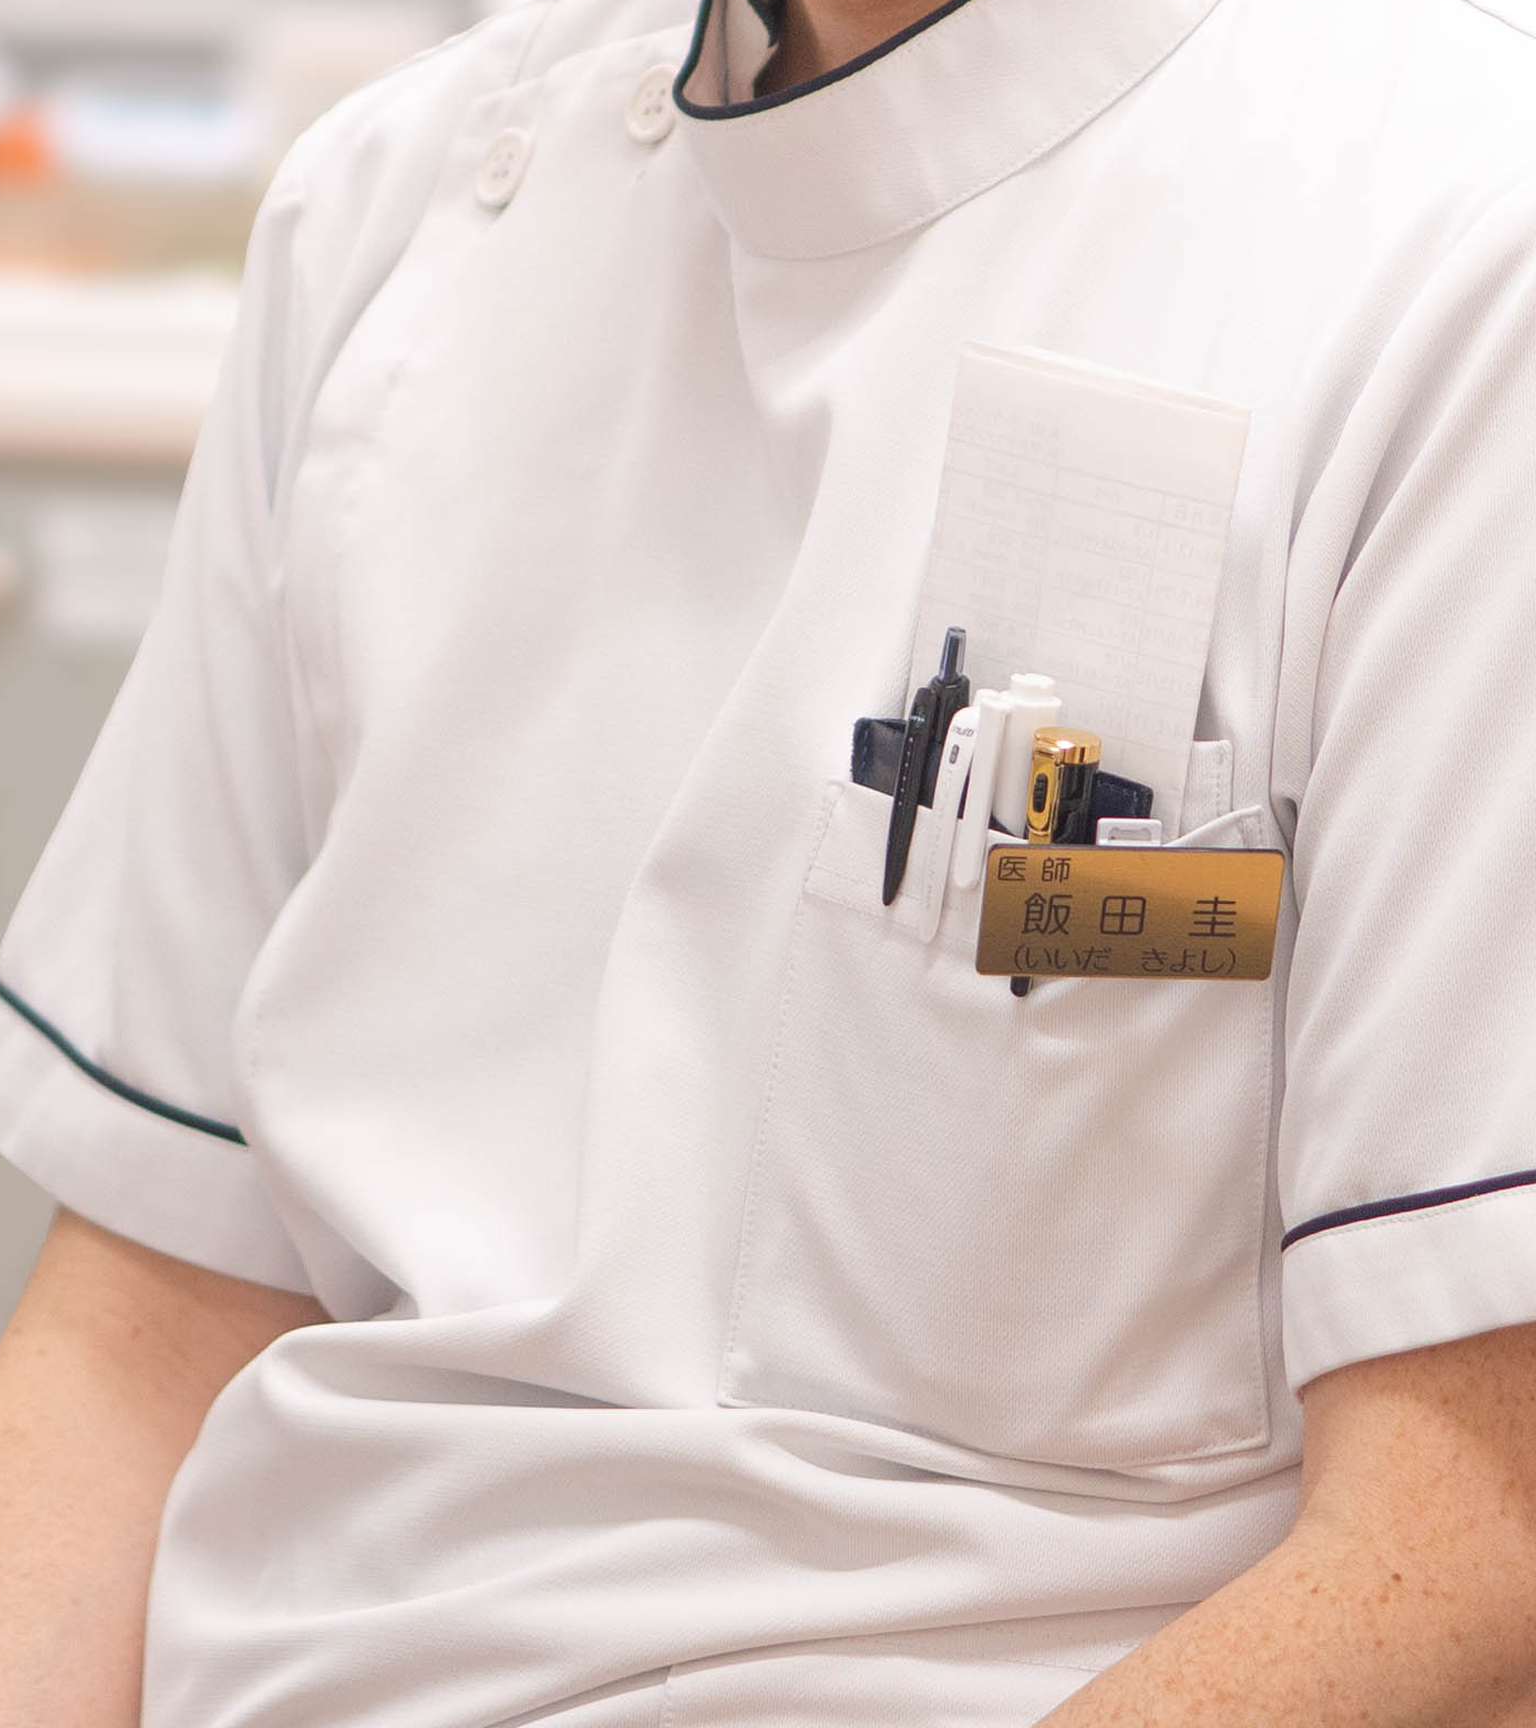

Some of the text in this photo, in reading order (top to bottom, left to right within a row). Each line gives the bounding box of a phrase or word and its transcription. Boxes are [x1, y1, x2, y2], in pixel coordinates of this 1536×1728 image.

[997, 855, 1071, 883] 医師
[1188, 895, 1237, 939] 圭
[1014, 944, 1237, 975] (いいだ きよし)
